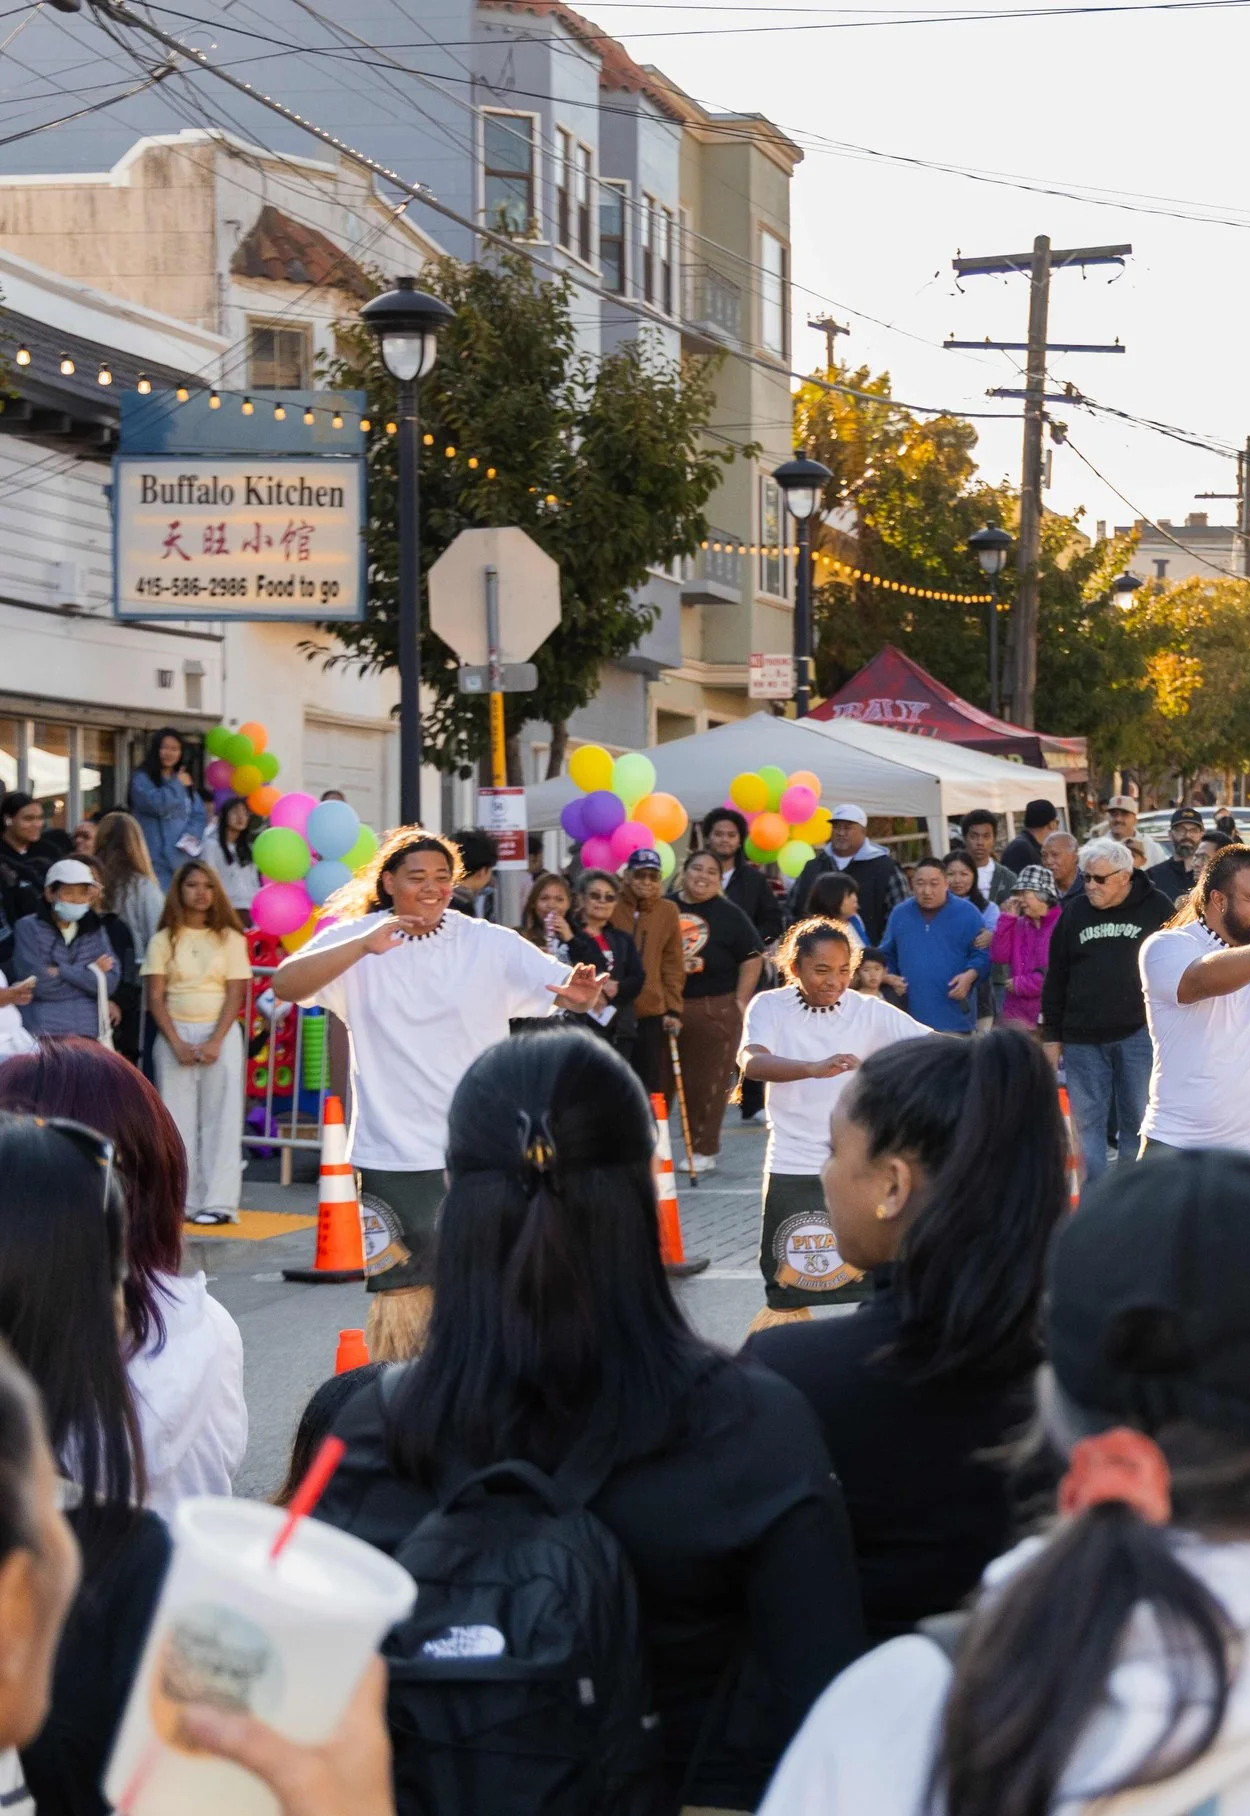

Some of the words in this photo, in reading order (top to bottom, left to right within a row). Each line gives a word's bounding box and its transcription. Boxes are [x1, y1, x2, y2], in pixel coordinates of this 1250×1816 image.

[140, 474, 235, 506] Buffalo
[243, 476, 345, 508] Kitchen
[135, 576, 248, 598] 415-586-2986
[256, 573, 295, 598] Food
[299, 576, 315, 598] to
[320, 580, 340, 604] go
[832, 698, 931, 723] BAY
[791, 1233, 838, 1249] PIYA
